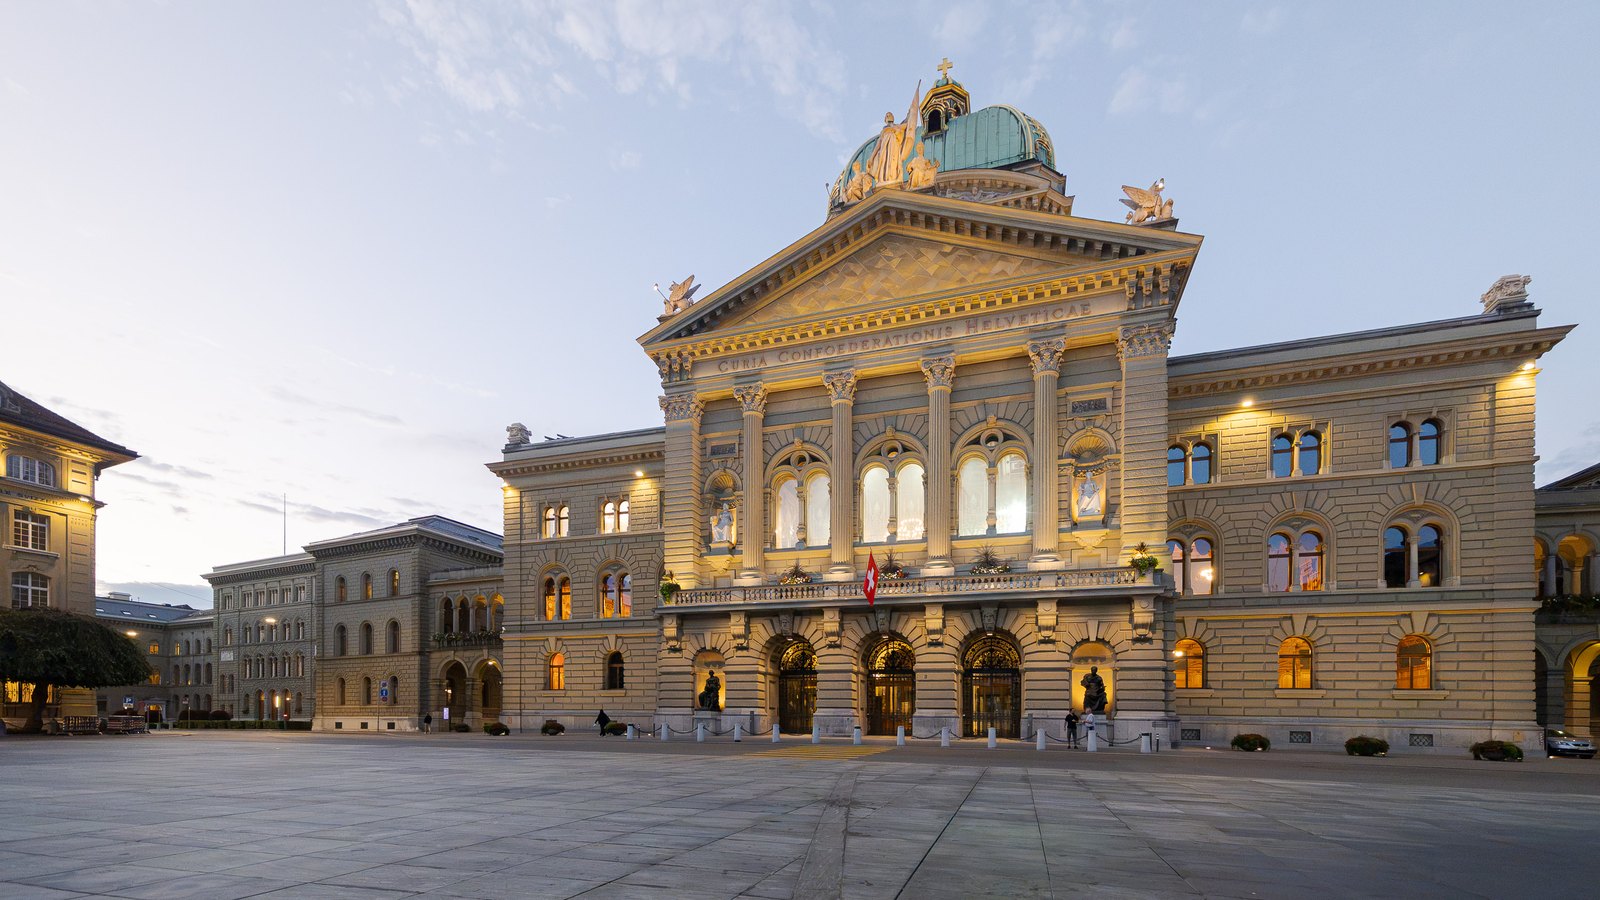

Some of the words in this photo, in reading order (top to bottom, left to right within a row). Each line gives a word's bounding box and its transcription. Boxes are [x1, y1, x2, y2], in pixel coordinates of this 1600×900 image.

[718, 355, 768, 373] CURIA
[778, 326, 953, 363] CONFOEDERATIONIS
[965, 302, 1092, 335] HELVETICAE
